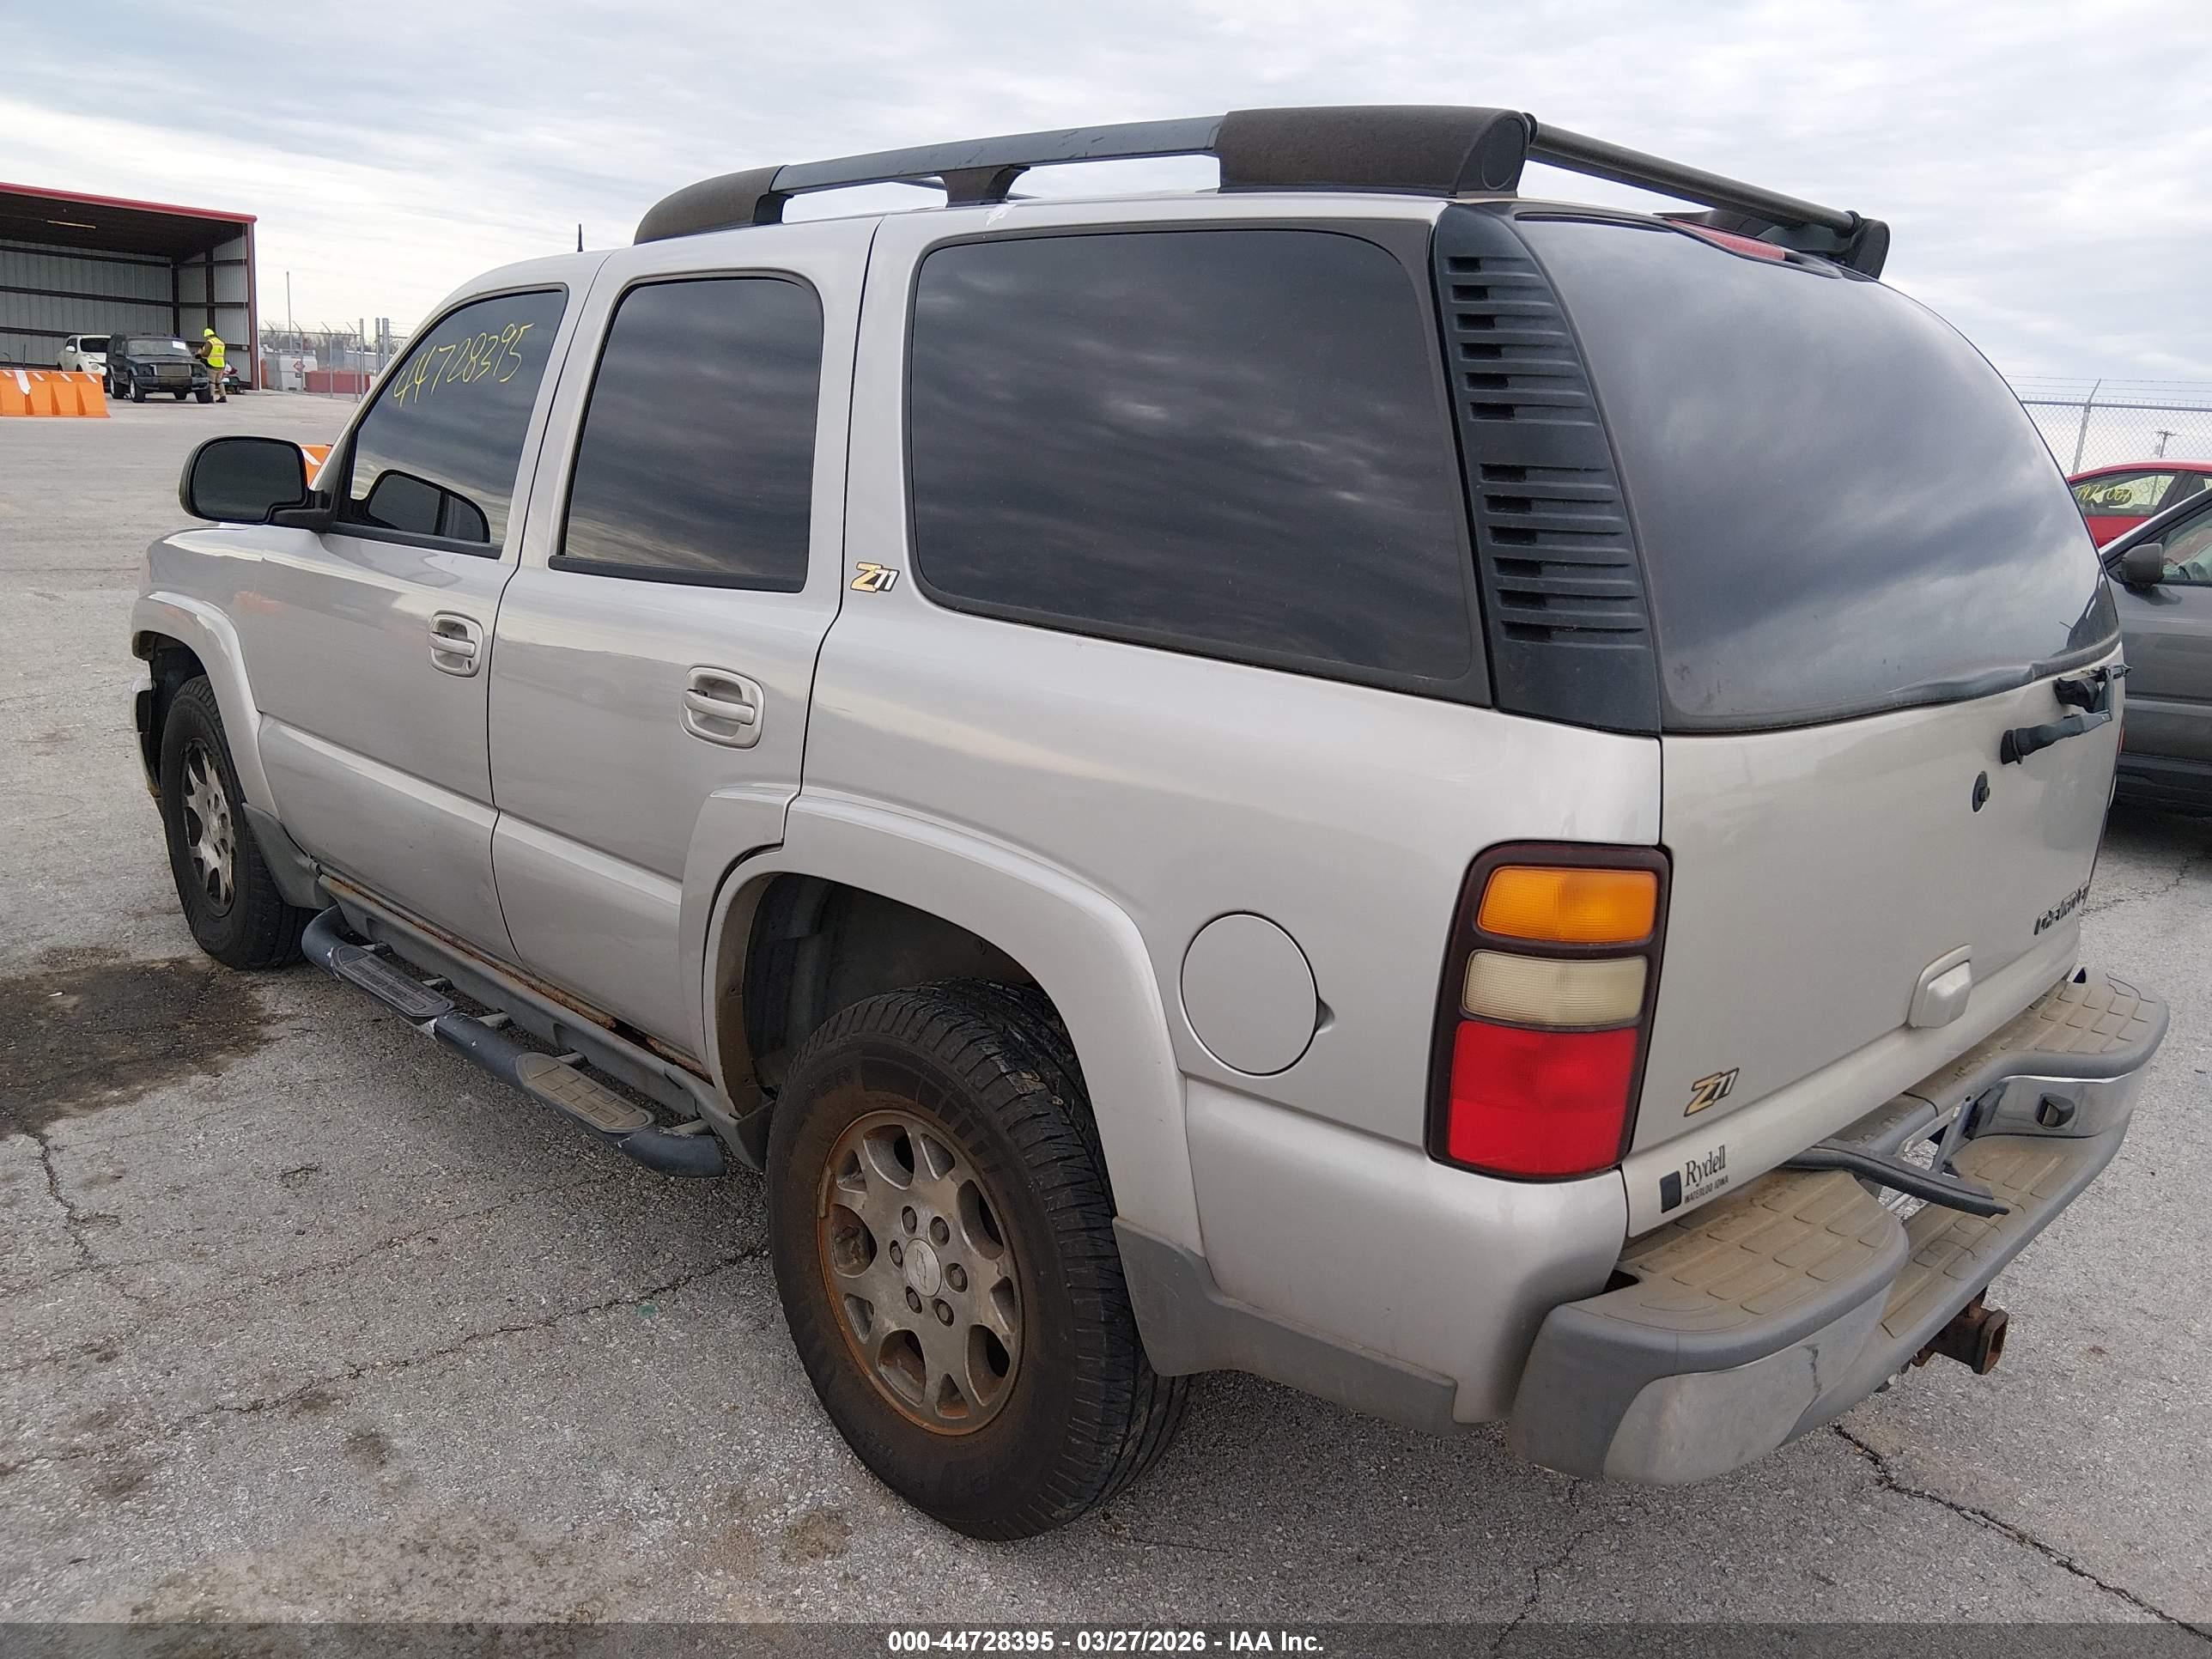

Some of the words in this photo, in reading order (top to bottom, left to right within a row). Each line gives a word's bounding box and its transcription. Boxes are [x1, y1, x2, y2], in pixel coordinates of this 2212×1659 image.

[393, 322, 535, 407] 44728395
[850, 561, 900, 592] Z71
[1683, 1067, 1740, 1117] Z71
[1685, 1144, 1725, 1187] Rydell
